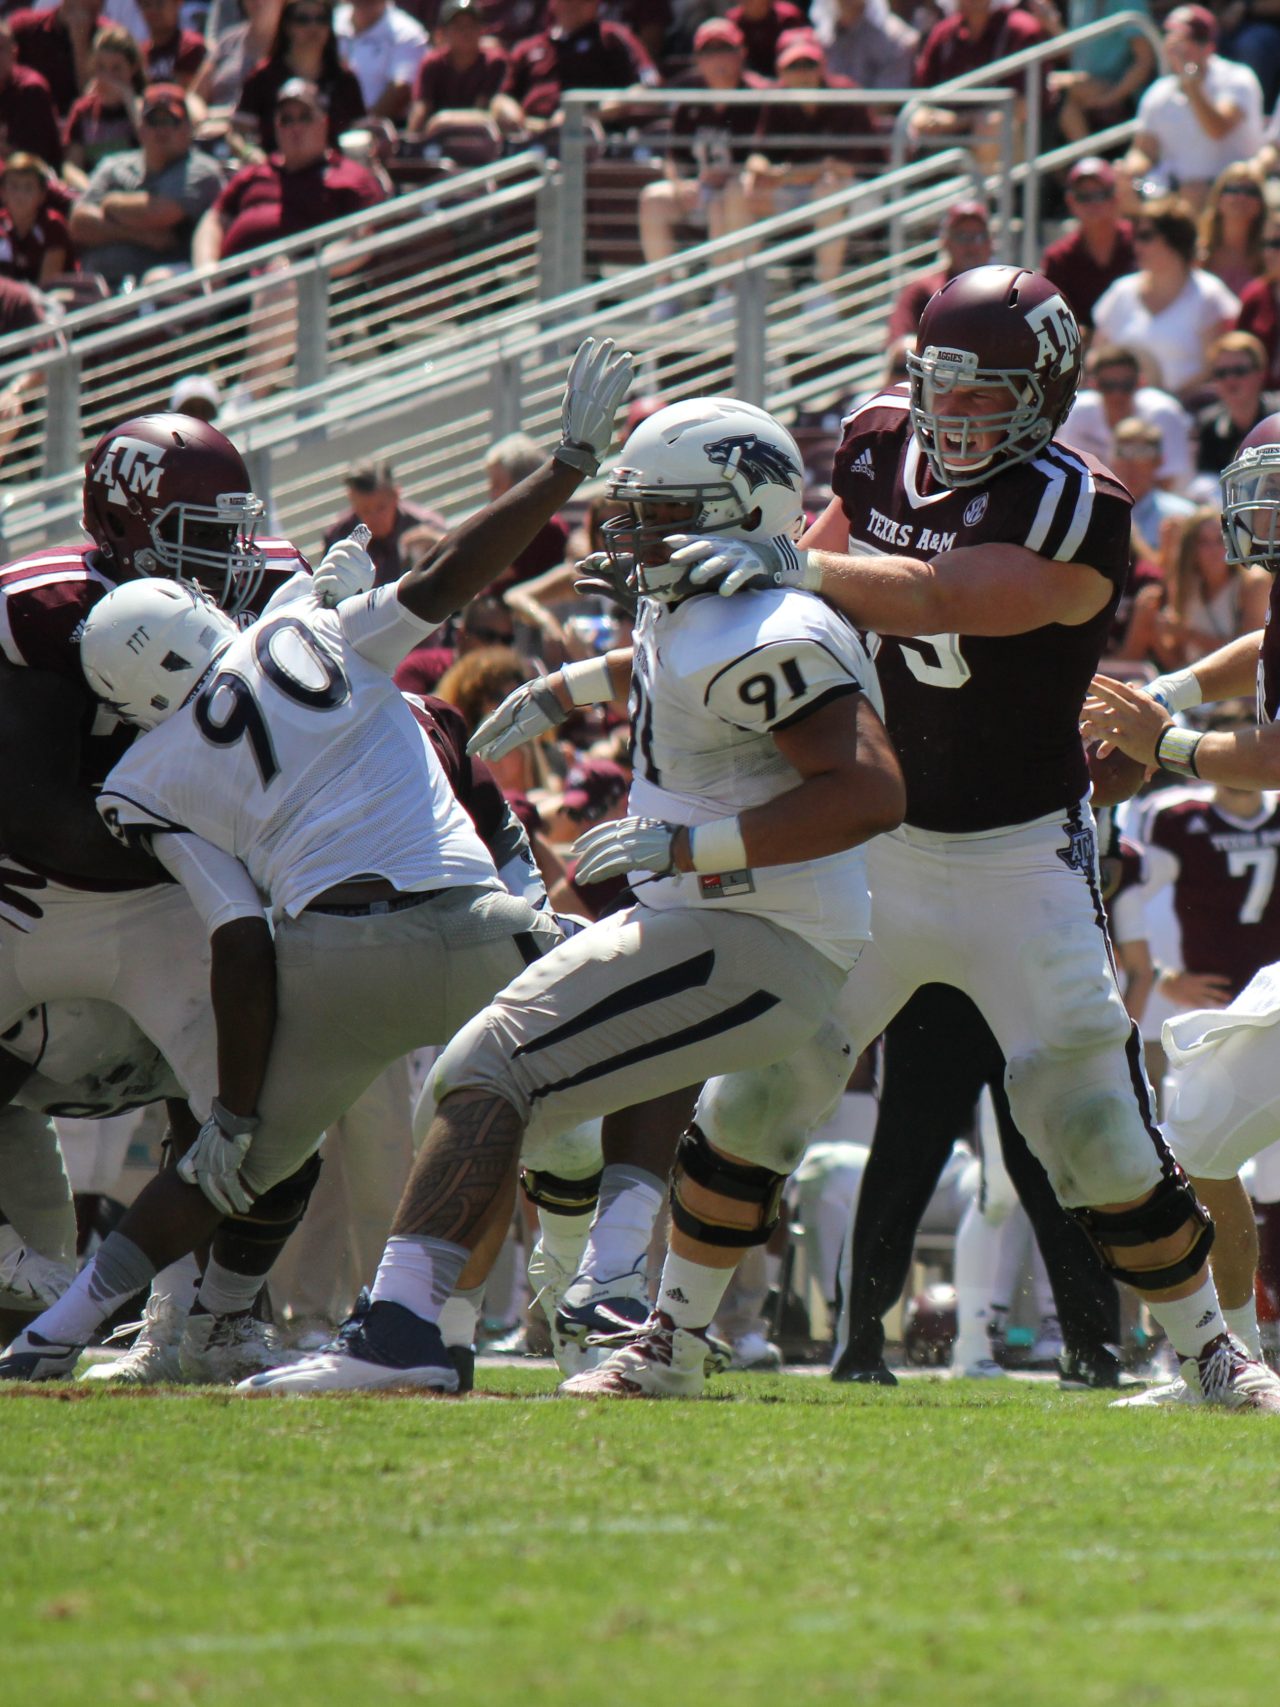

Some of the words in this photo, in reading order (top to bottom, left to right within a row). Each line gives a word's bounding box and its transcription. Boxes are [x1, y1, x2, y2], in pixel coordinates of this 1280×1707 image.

[937, 351, 963, 363] AGGIES
[851, 464, 875, 481] adidas
[866, 507, 913, 547] TEXAS
[916, 527, 957, 553] A&M
[192, 615, 352, 792] 90
[738, 657, 808, 721] 91
[1227, 847, 1278, 924] 7
